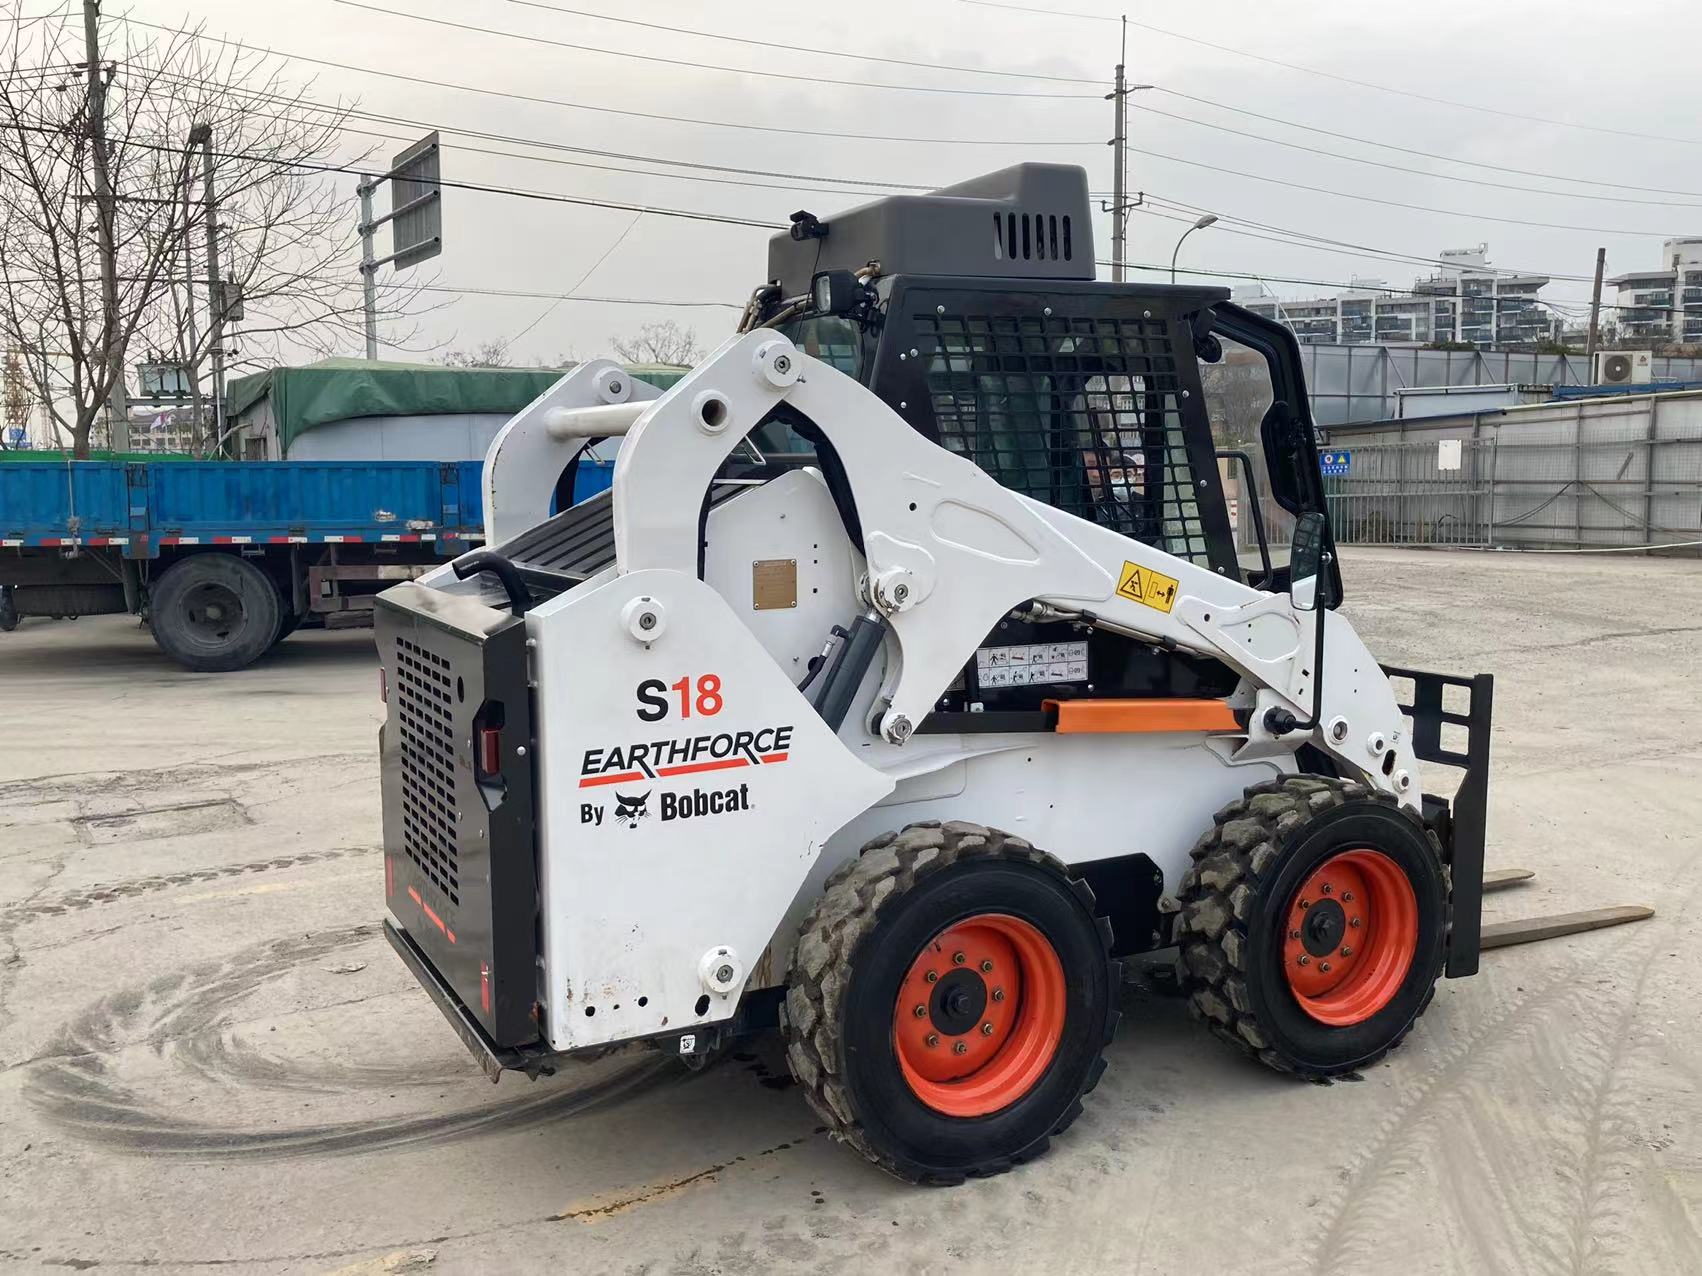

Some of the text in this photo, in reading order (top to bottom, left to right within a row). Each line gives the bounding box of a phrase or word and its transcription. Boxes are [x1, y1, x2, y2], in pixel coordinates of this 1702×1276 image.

[636, 674, 723, 722] S18
[581, 726, 794, 778] EARTHFORCE
[580, 783, 749, 826] By Bobcat
